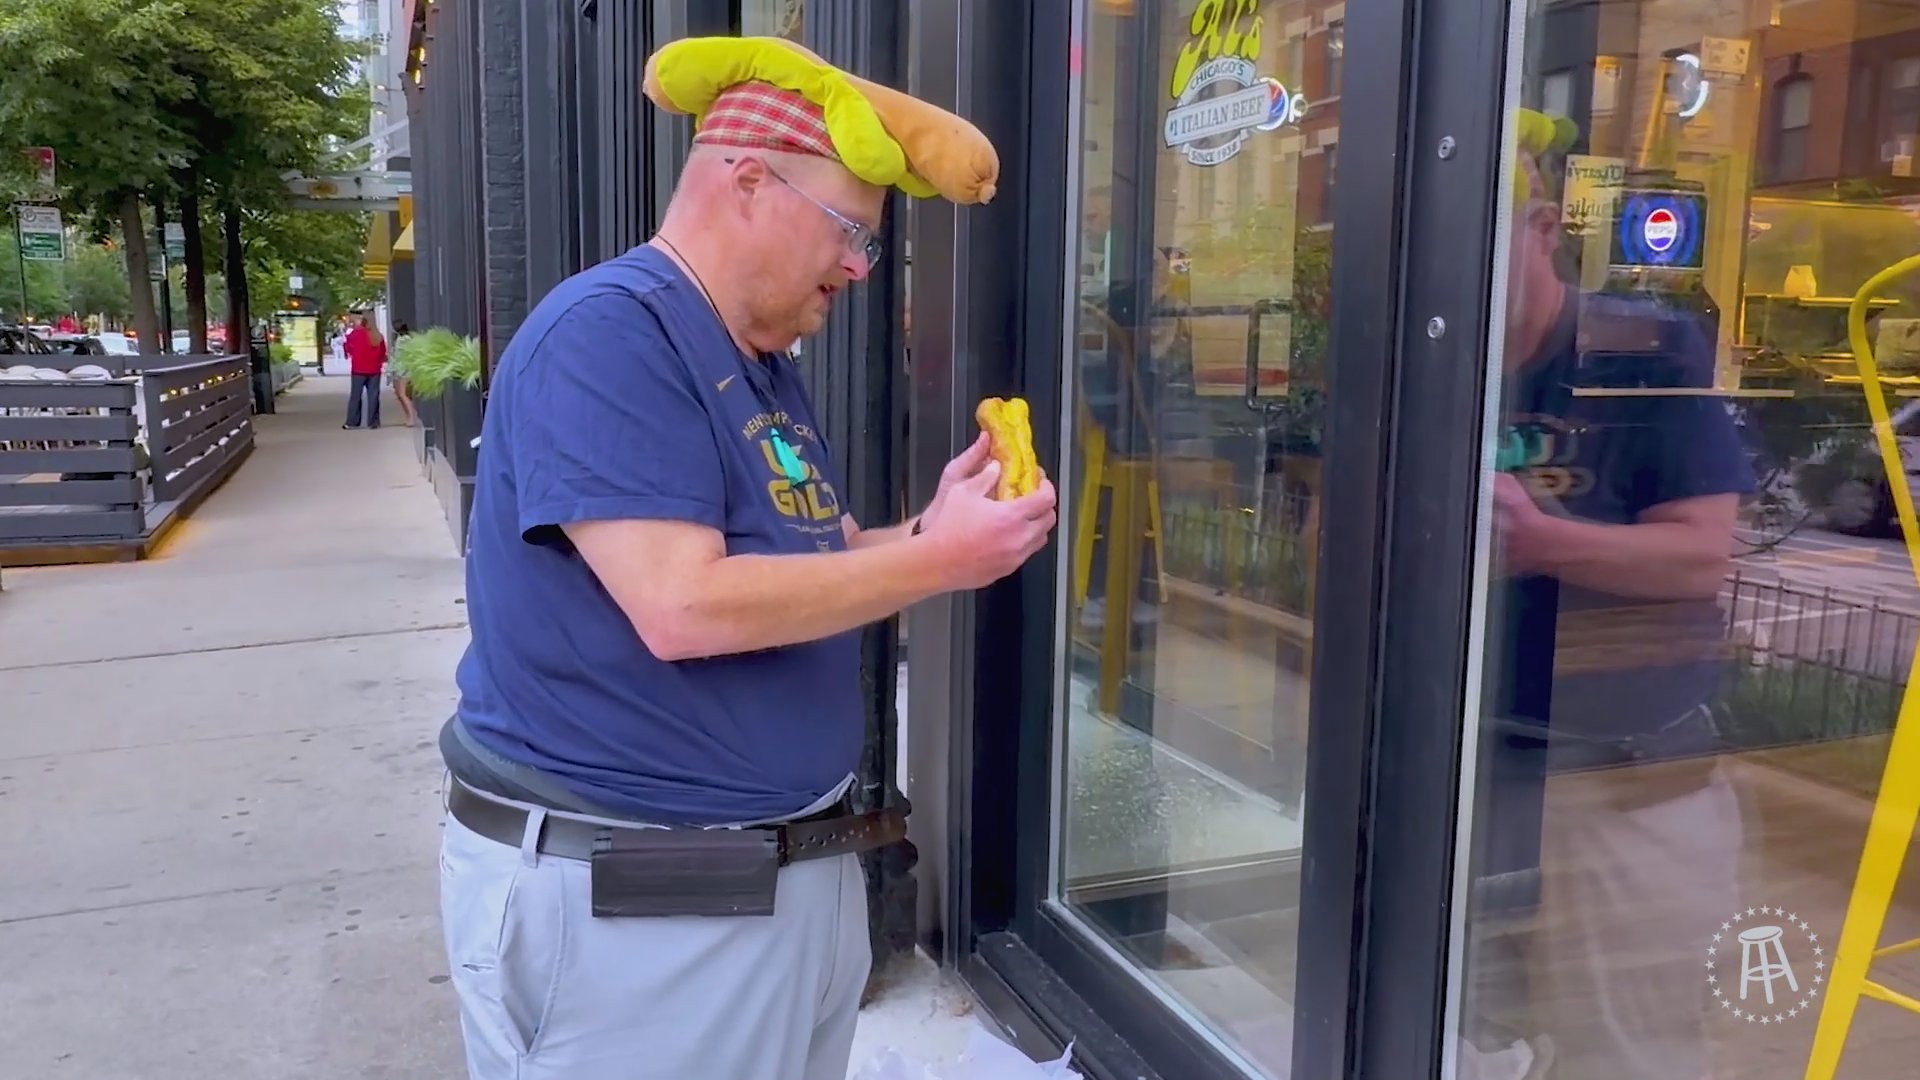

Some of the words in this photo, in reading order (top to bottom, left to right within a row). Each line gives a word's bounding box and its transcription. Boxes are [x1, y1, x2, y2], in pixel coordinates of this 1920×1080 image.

[1172, 0, 1263, 98] Al's
[1191, 62, 1245, 90] CHICAGO'S
[1169, 118, 1178, 136] #1
[1181, 103, 1228, 134] ITALIAN
[1231, 95, 1265, 120] BEEF
[1191, 149, 1214, 163] SINCE
